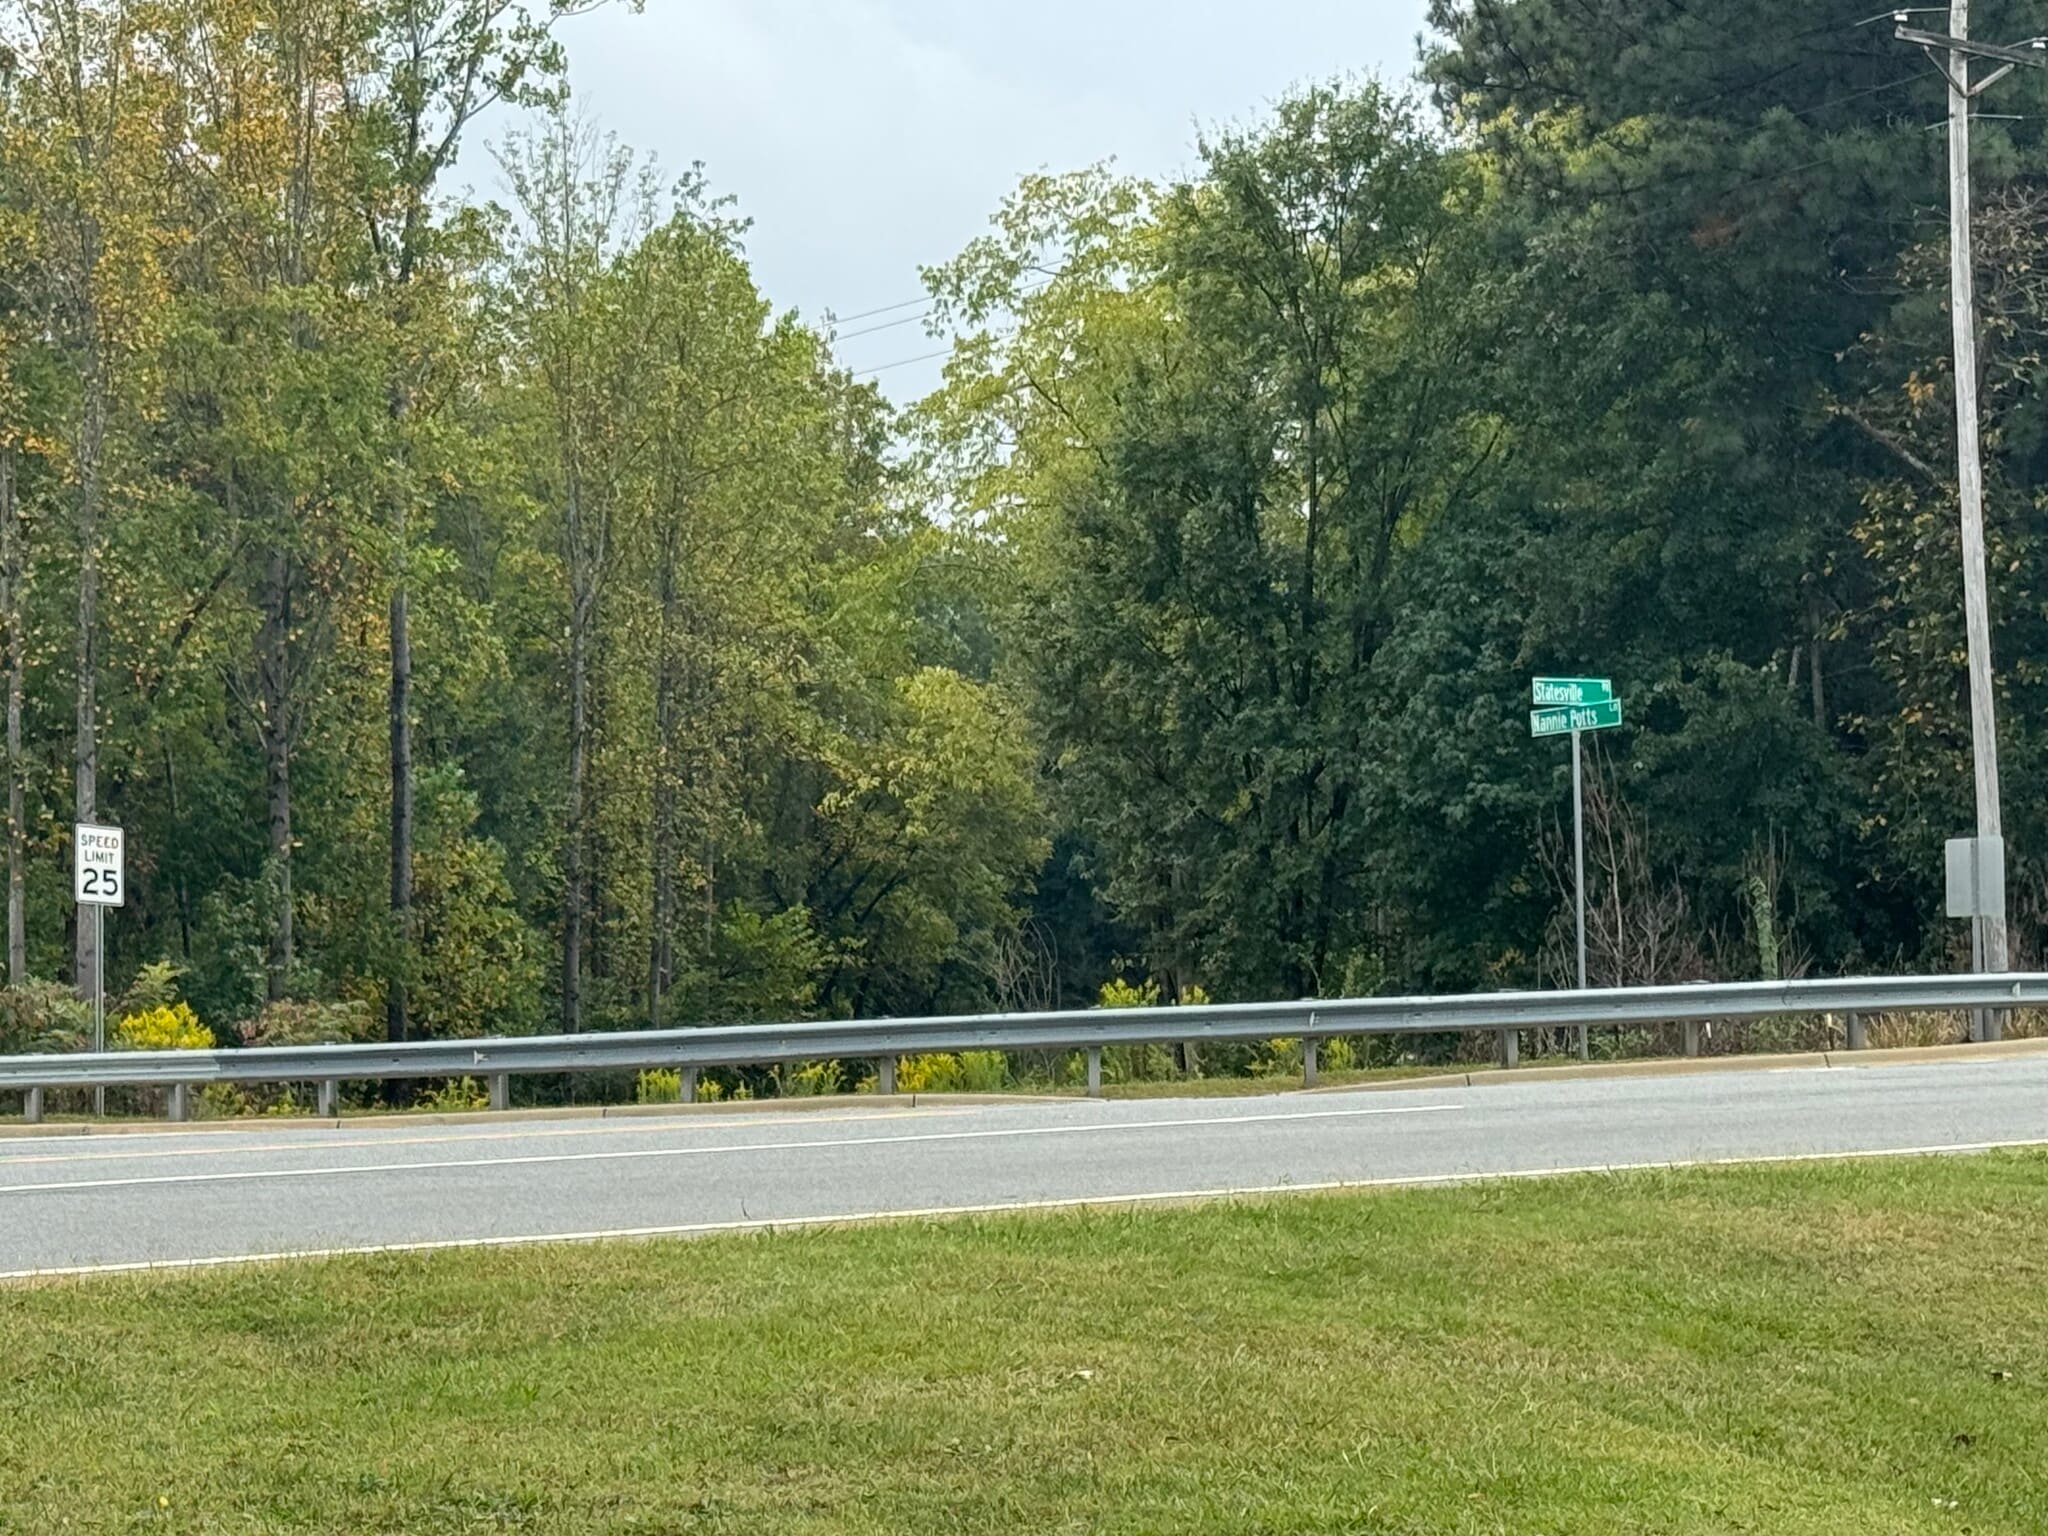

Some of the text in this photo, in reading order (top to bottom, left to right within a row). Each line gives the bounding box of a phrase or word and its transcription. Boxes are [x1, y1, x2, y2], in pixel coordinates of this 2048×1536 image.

[1536, 682, 1583, 701] Statesville
[1534, 712, 1567, 732] Nannie
[1570, 708, 1598, 728] Potts
[81, 834, 119, 849] SPEED
[84, 850, 114, 864] LIMIT
[83, 868, 118, 896] 25
